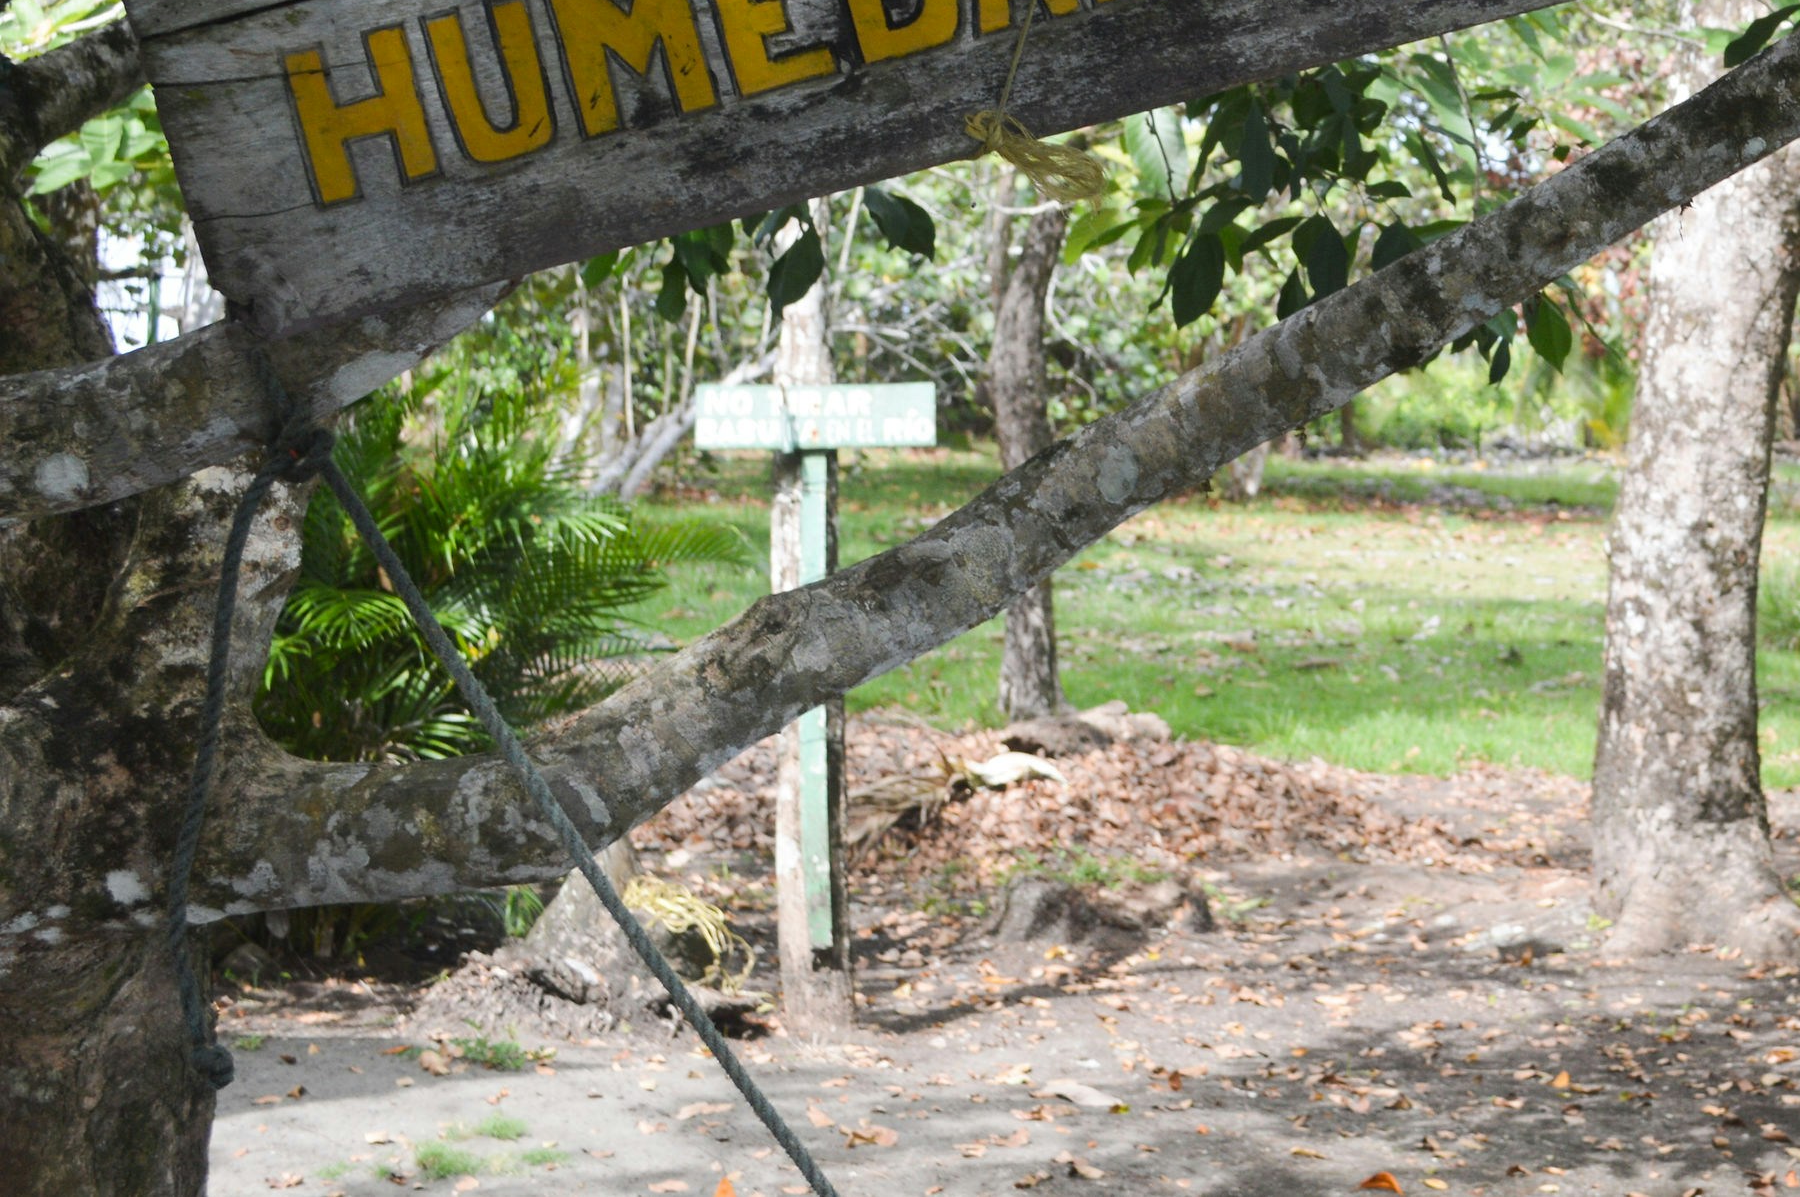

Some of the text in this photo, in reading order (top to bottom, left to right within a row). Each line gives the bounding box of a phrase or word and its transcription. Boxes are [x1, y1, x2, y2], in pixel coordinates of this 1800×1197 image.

[703, 388, 874, 417] NO TIRAR
[696, 416, 821, 444] BASUA
